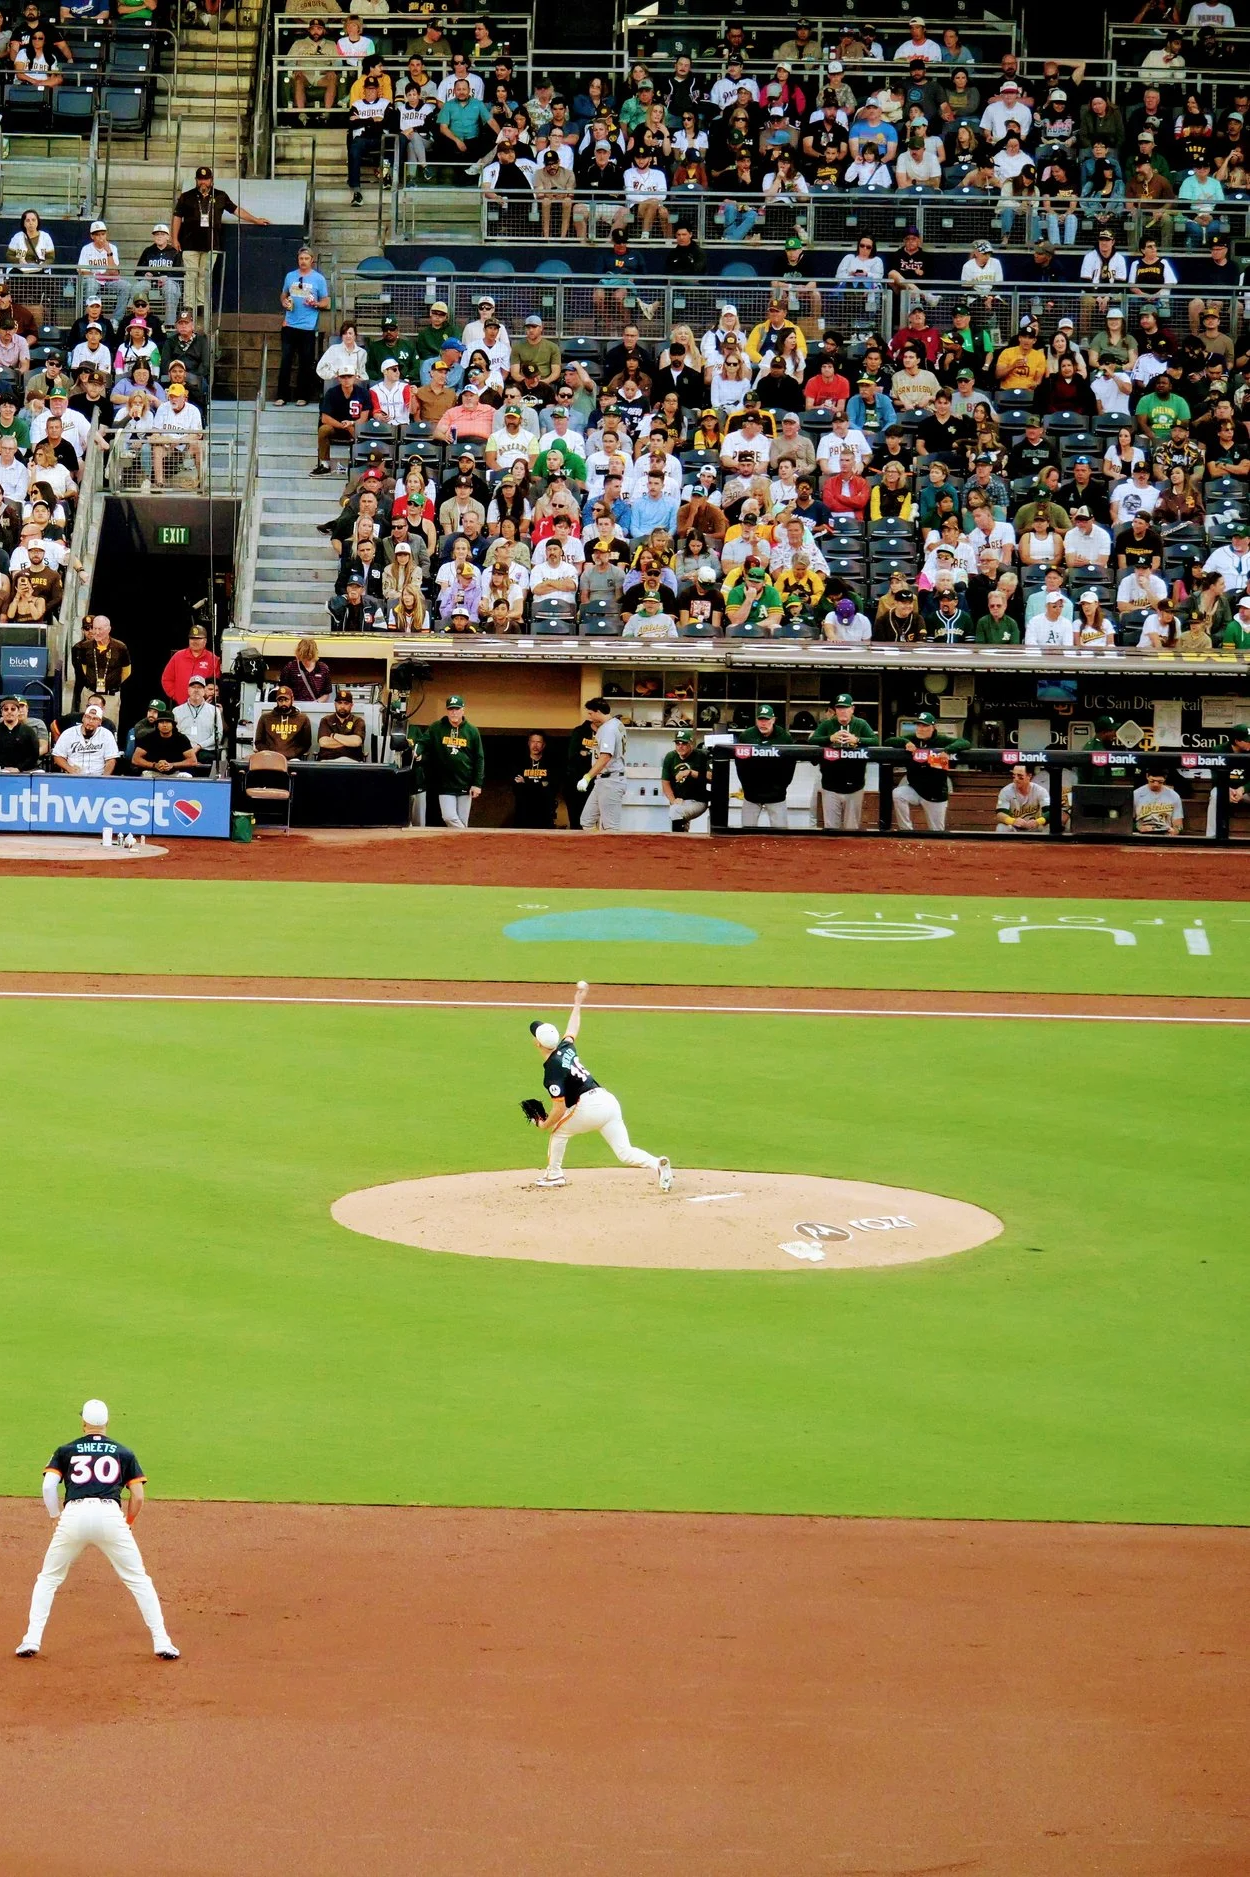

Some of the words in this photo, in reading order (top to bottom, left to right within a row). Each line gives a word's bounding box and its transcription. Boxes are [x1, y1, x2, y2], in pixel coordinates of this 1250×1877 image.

[162, 527, 186, 543] EXIT
[9, 656, 29, 665] blue
[271, 724, 297, 733] PADRES
[69, 741, 105, 753] Padres
[735, 748, 752, 758] us
[751, 747, 780, 758] bank
[825, 749, 840, 759] us
[840, 749, 869, 760] bank
[914, 750, 928, 760] us
[1002, 753, 1018, 763] us
[1018, 752, 1048, 763] bank
[1092, 755, 1107, 764] us
[1108, 753, 1137, 765] bank
[1182, 756, 1197, 766] us
[1197, 755, 1227, 767] bank
[76, 1442, 118, 1454] SHEETS
[69, 1455, 120, 1485] 30
